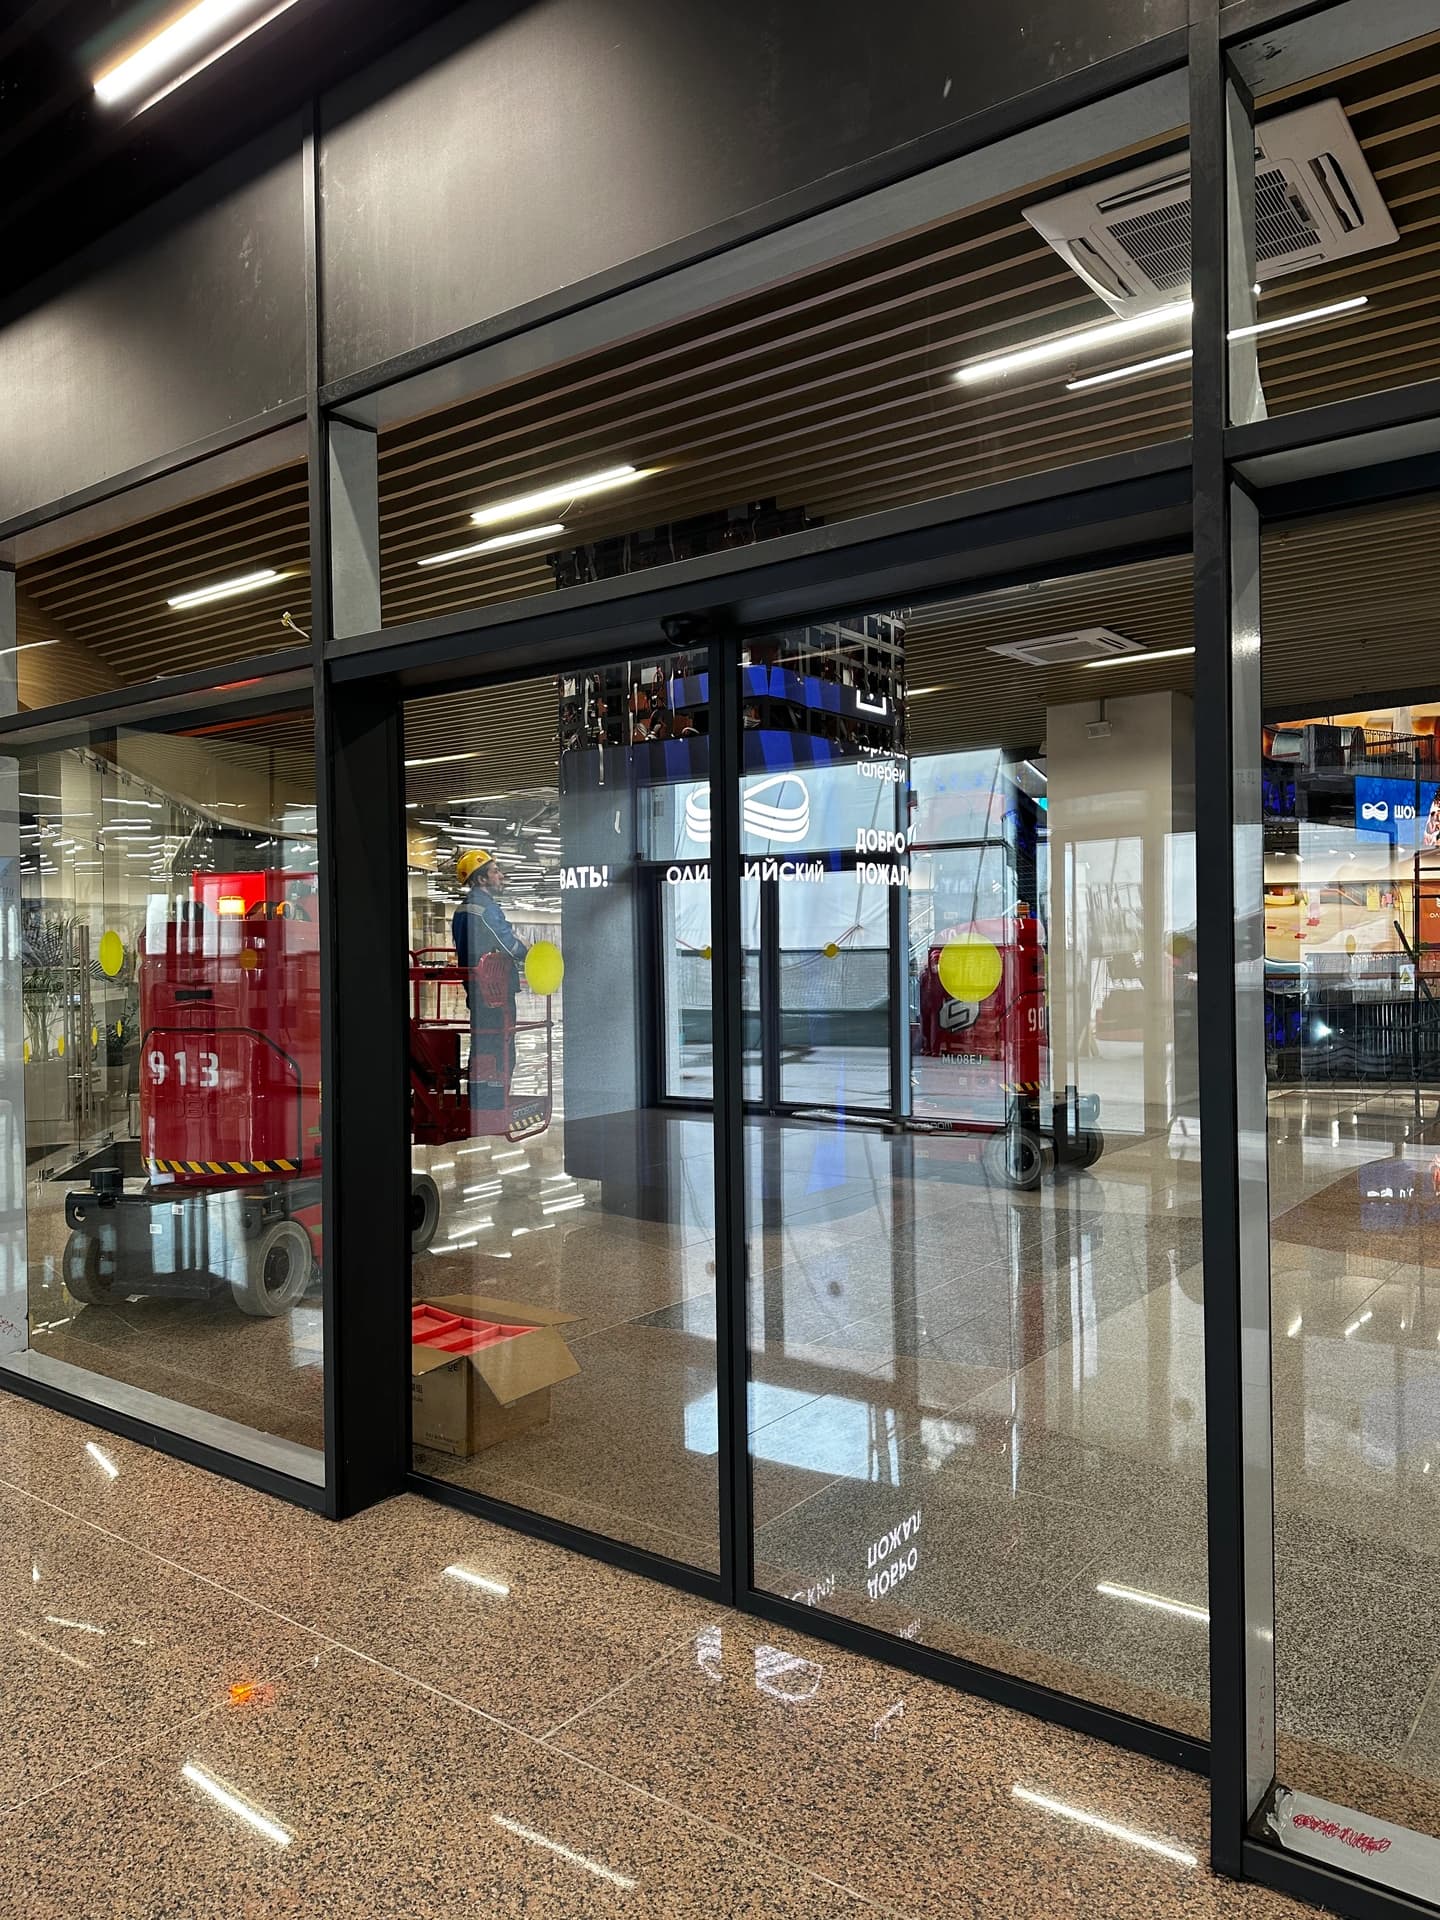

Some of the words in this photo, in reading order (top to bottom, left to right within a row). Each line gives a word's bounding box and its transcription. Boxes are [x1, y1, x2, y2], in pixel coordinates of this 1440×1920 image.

[856, 760, 906, 785] галереи
[855, 827, 906, 855] ДОБРО
[147, 1050, 220, 1088] 913
